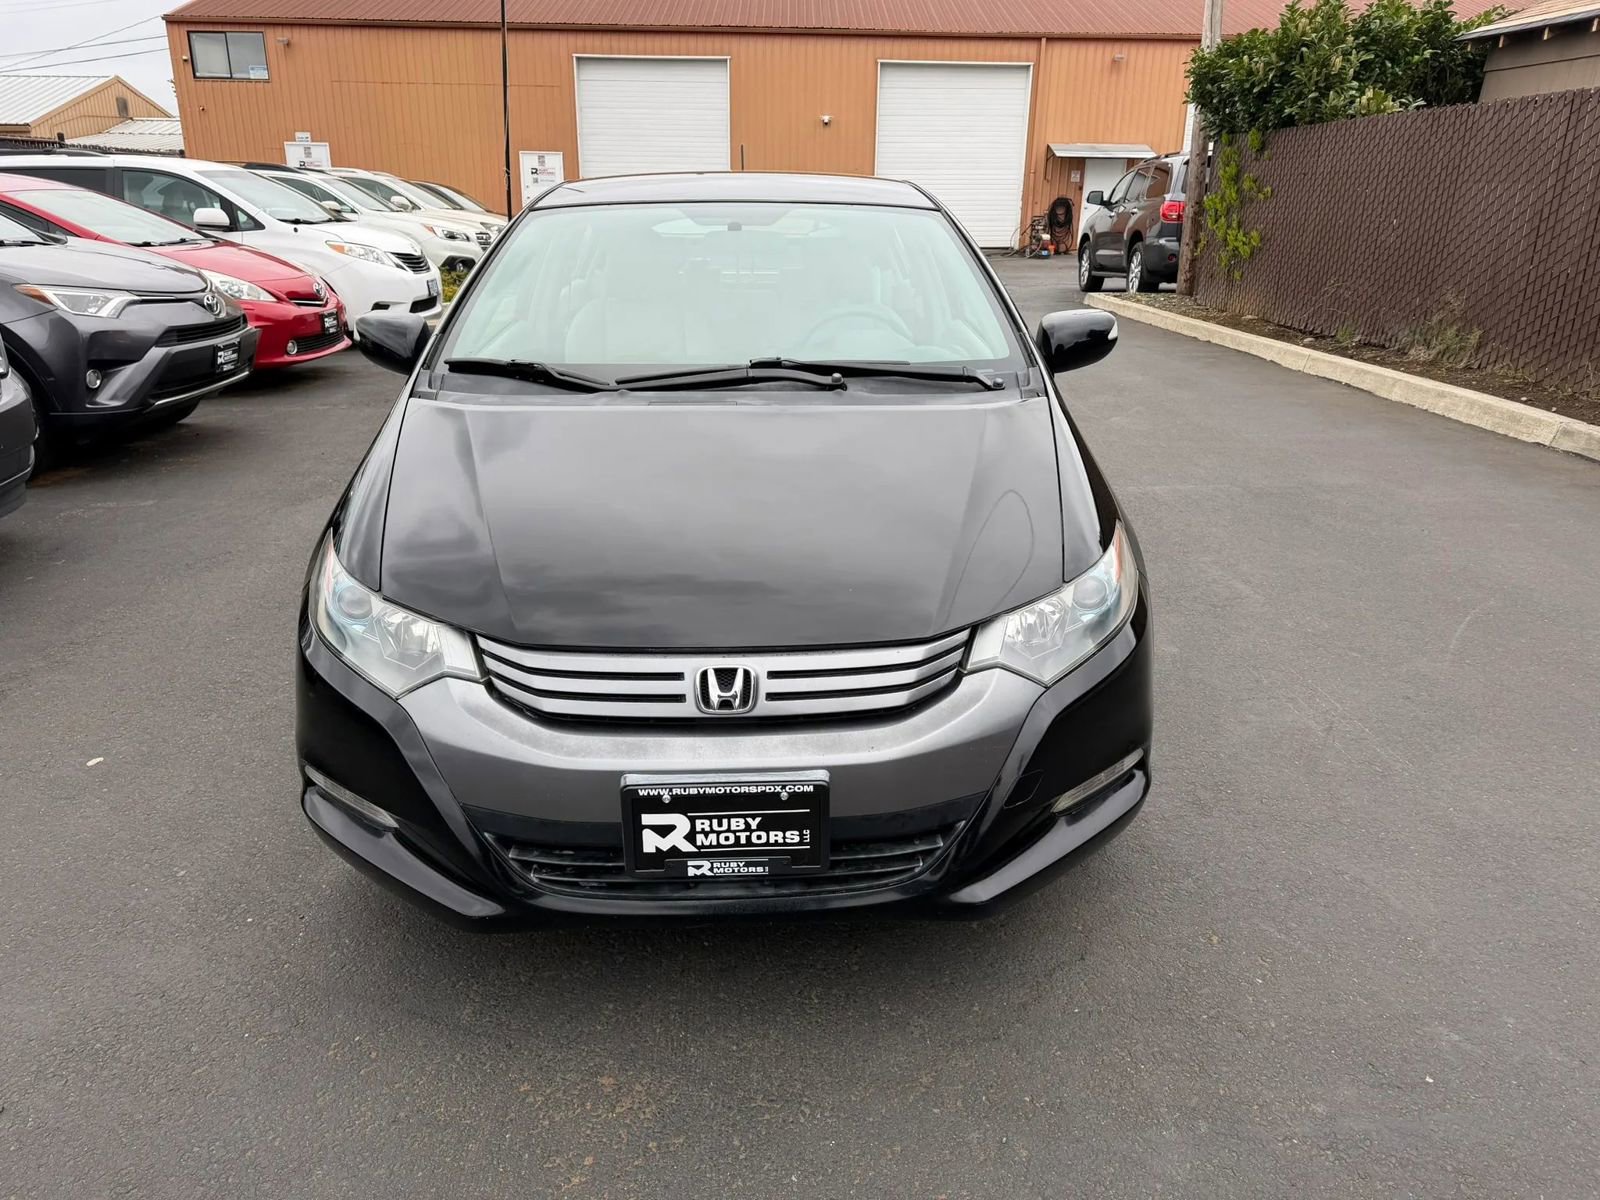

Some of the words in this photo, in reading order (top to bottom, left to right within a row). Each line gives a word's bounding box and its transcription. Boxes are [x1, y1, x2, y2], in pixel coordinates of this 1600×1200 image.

[638, 785, 814, 797] WWW.RUBYMOTORSPDX.COM
[695, 817, 762, 832] RUBY
[695, 830, 801, 847] MOTORS
